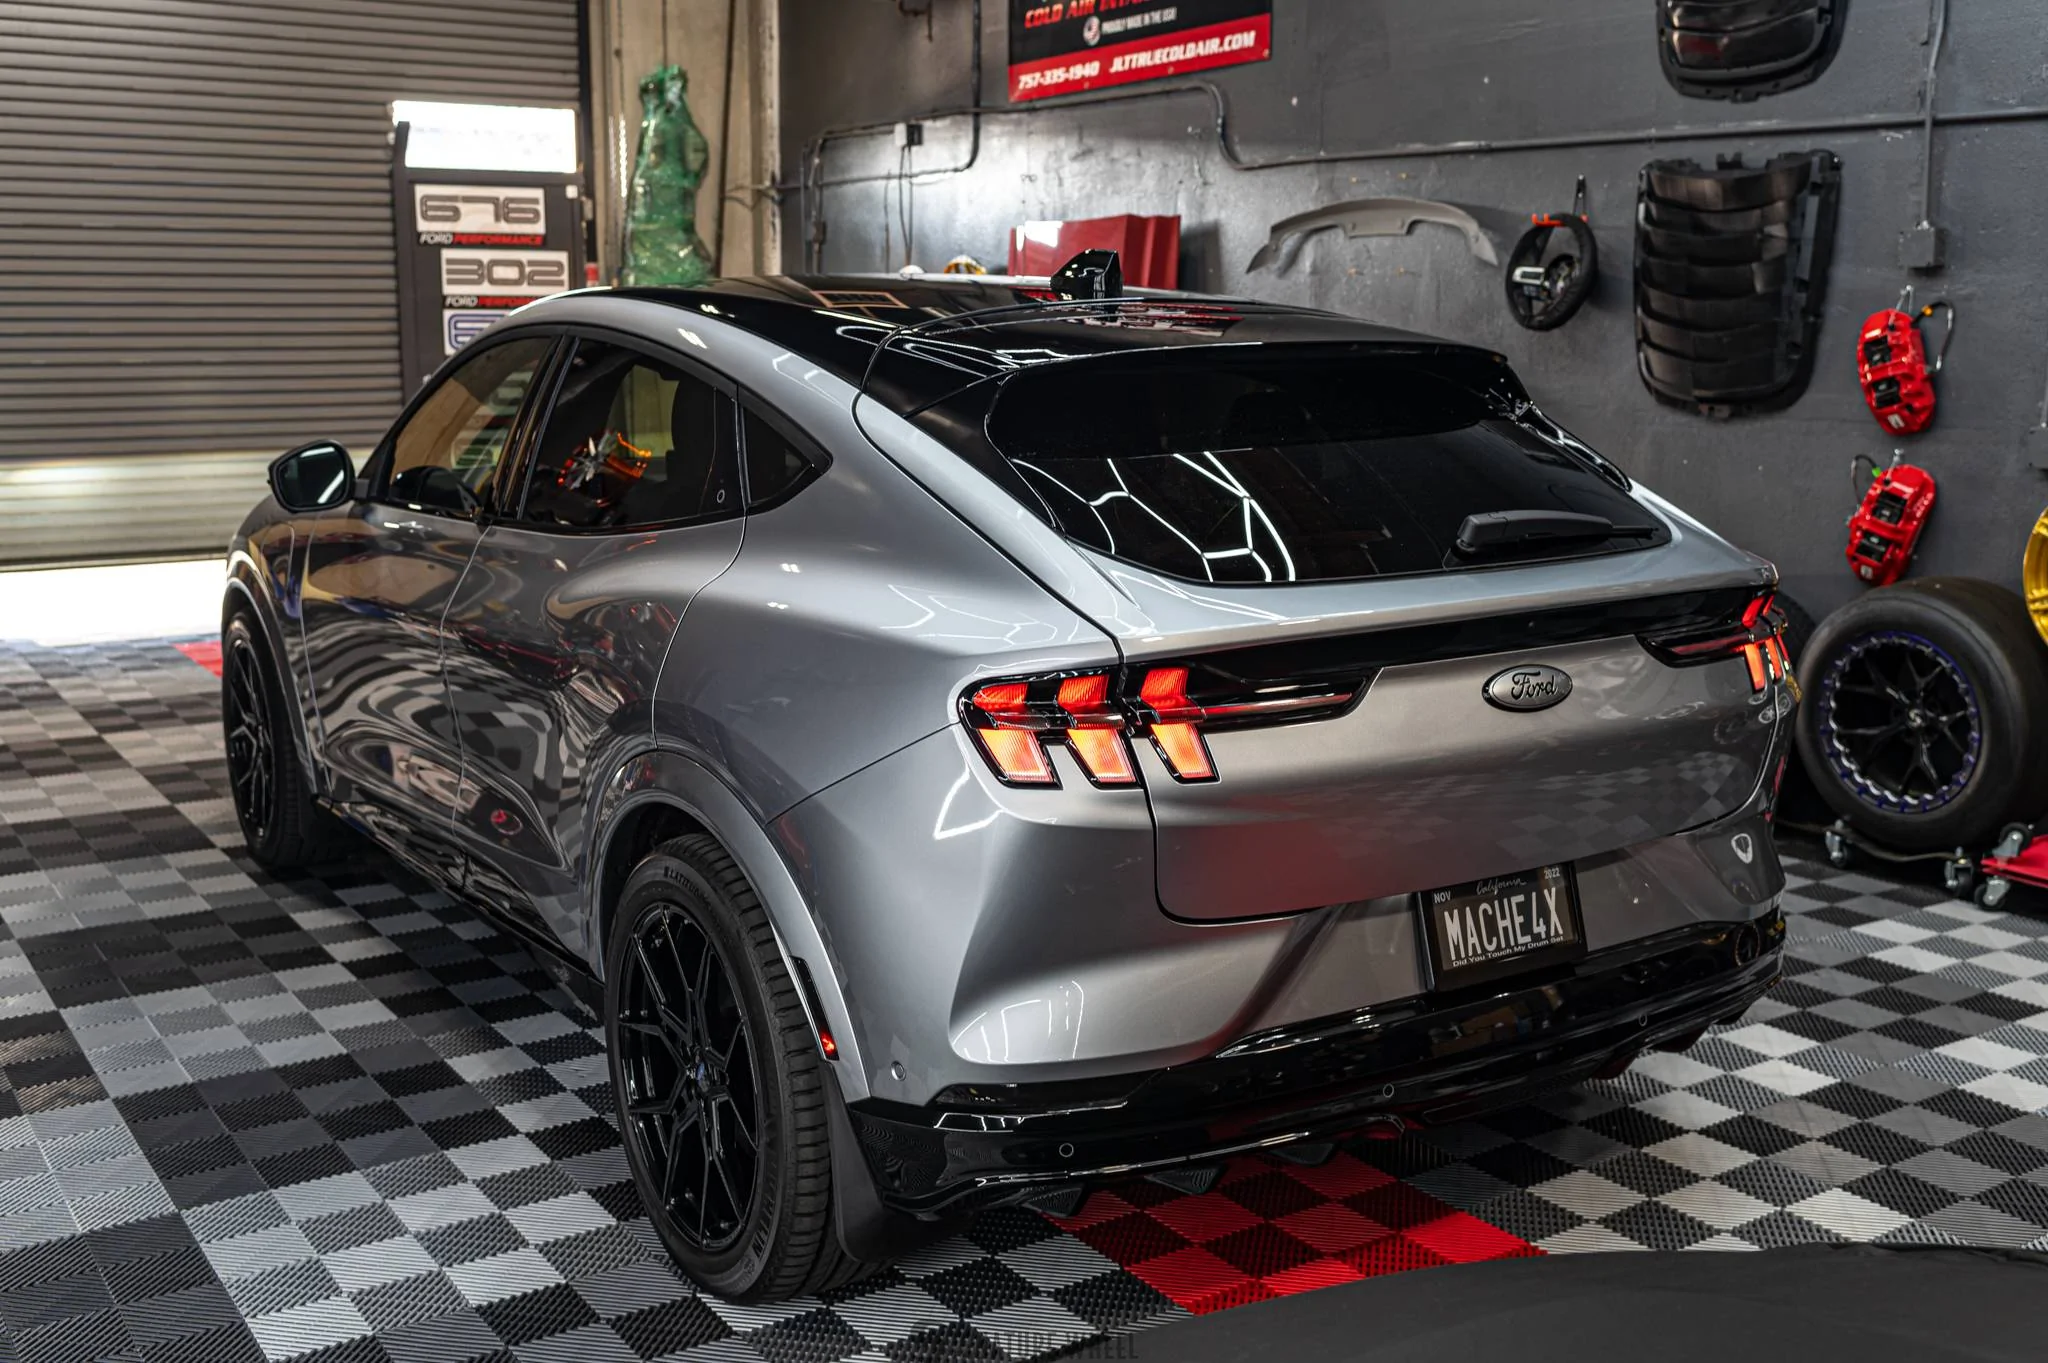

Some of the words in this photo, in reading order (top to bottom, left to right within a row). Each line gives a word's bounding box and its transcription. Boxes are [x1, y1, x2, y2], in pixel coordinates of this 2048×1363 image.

[1024, 3, 1063, 28] COLD
[1066, 0, 1095, 19] AIR
[1018, 60, 1100, 90] 757-335-1940
[1109, 30, 1257, 73] JLTTRUECOLDAIR.COM
[420, 194, 541, 224] 676
[420, 232, 453, 245] FORD
[445, 258, 566, 287] 302
[444, 295, 478, 307] FORD
[1511, 670, 1558, 700] Ford
[1434, 891, 1451, 904] NOV
[1476, 877, 1527, 896] California
[1543, 867, 1560, 880] 2022
[1444, 887, 1563, 961] MACHE4X
[1453, 958, 1468, 968] Did
[1470, 954, 1485, 964] You
[1487, 949, 1512, 959] Touch
[1514, 945, 1526, 953] My
[1527, 939, 1549, 949] Drum
